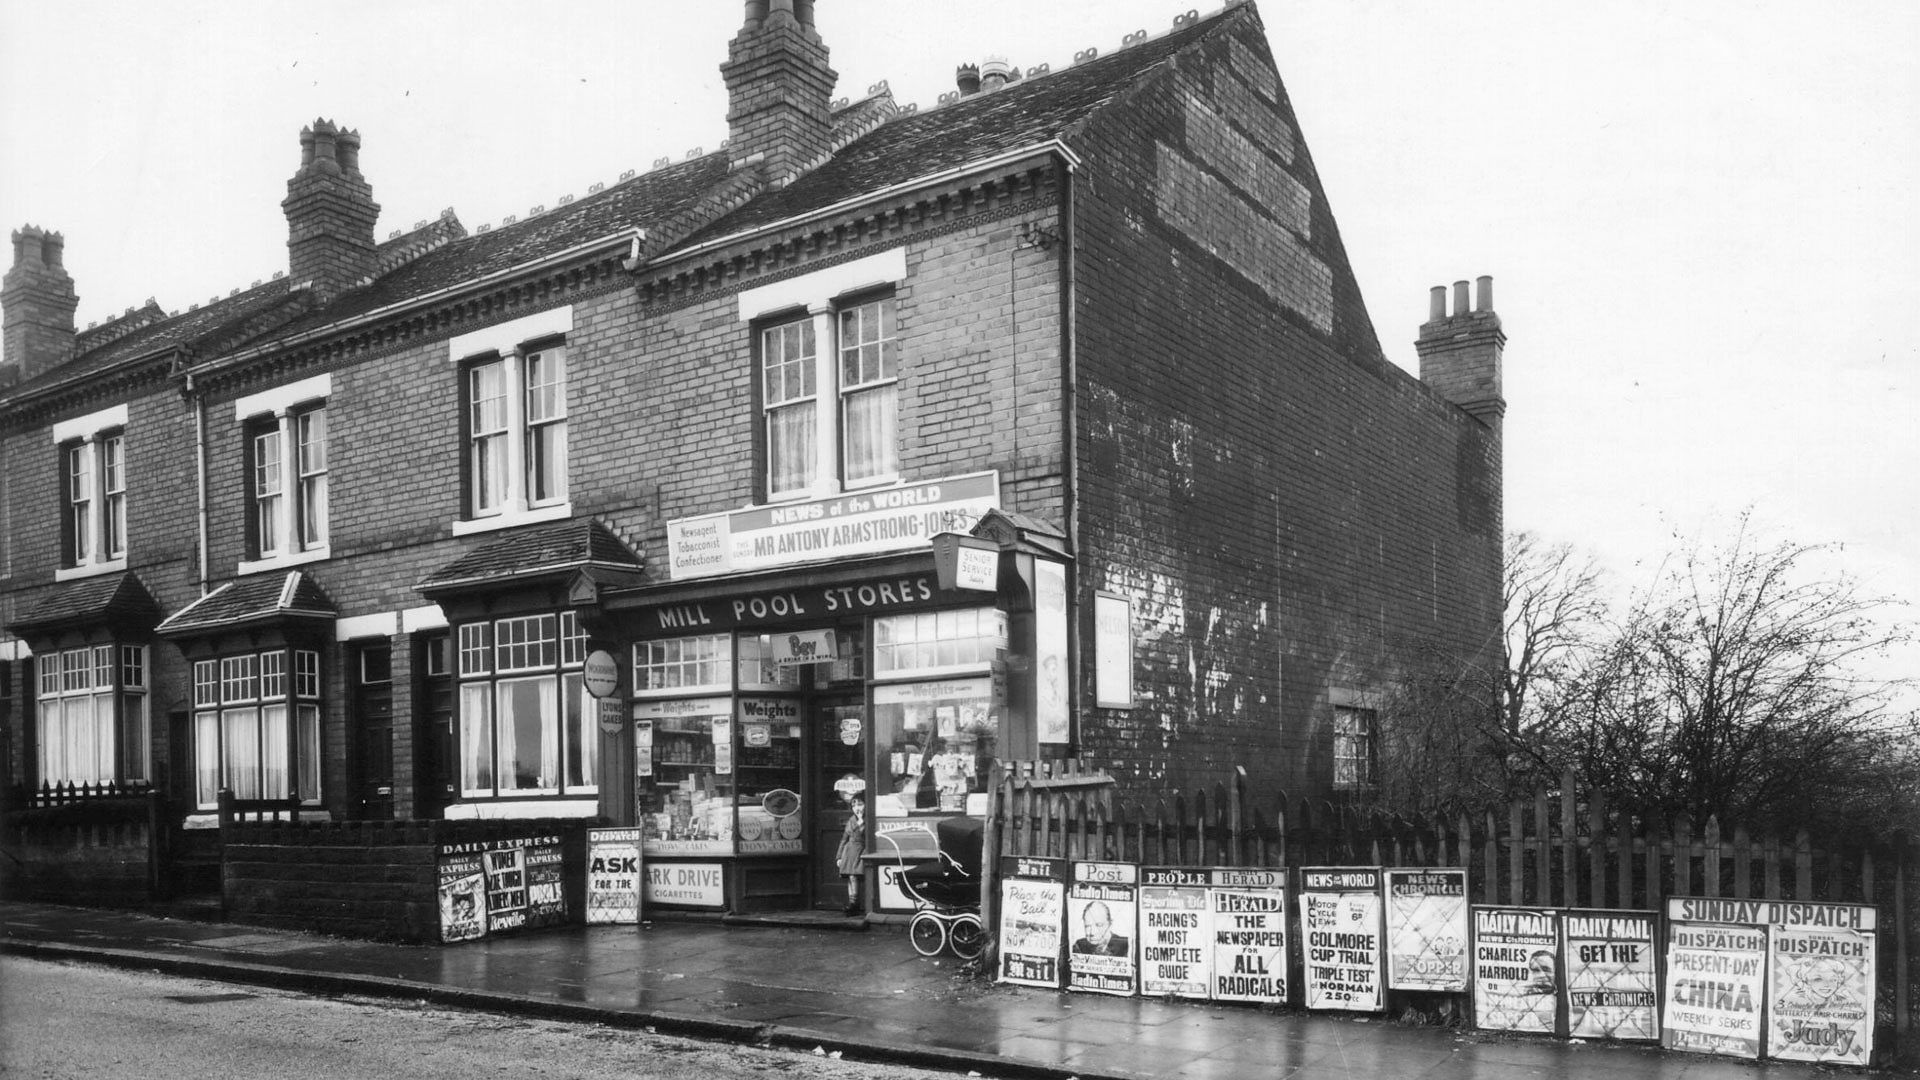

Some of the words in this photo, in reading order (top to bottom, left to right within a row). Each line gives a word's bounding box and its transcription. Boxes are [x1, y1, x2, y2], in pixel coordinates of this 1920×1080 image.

[771, 503, 824, 524] NEWS
[830, 501, 842, 516] of
[848, 498, 870, 512] the
[872, 486, 941, 508] WORLD
[680, 523, 716, 538] Newsagent
[677, 538, 720, 553] Tobacconist
[754, 535, 775, 558] MR
[778, 527, 830, 554] ANTONY
[676, 554, 722, 568] Confectioner
[964, 550, 991, 564] SENIOR
[962, 561, 992, 576] SERVICE
[657, 604, 710, 629] MILL
[733, 592, 805, 620] POOL
[824, 578, 931, 612] STORES
[912, 683, 954, 698] Weights
[602, 702, 622, 712] LYONS
[662, 702, 696, 715] Weights
[744, 702, 796, 719] Weights
[602, 714, 622, 724] CAKES
[443, 842, 490, 854] DAILY
[498, 836, 560, 848] EXPRESS
[526, 854, 562, 864] EXPRESS
[590, 858, 638, 873] ASK
[440, 863, 480, 874] EXPRESS
[1018, 864, 1050, 876] Mail
[1086, 864, 1123, 881] Post
[595, 880, 611, 889] FOR
[616, 880, 632, 889] THE
[678, 869, 720, 887] DRIVE
[1148, 872, 1205, 884] PEOPLE
[1222, 872, 1275, 885] HERALD
[1307, 874, 1333, 887] NEWS
[1342, 874, 1375, 887] WORLD
[1408, 875, 1447, 884] NEWS
[655, 889, 703, 899] CIGARETTES
[1073, 884, 1101, 899] Radio
[1101, 886, 1131, 900] Times
[1392, 884, 1463, 894] CHRONICLE
[1216, 894, 1282, 912] HERALD
[1308, 896, 1337, 908] MOTOR
[1148, 913, 1198, 928] RACING'S
[1308, 908, 1337, 918] CYCLE
[1682, 900, 1761, 923] SUNDAY
[1768, 904, 1861, 928] DISPATCH
[1234, 915, 1266, 928] THE
[1308, 918, 1336, 928] NEWS
[1479, 914, 1516, 934] DAILY
[1518, 915, 1554, 936] MAIL
[1569, 918, 1610, 938] DAILY
[1612, 919, 1650, 939] MAIL
[1158, 930, 1188, 945] MOST
[1217, 931, 1284, 946] NEWSPAPER
[1310, 932, 1375, 950] COLMORE
[1480, 935, 1503, 943] NEWS
[1506, 937, 1554, 945] CHRONICLE
[1678, 933, 1757, 949] DISPATCH
[1479, 947, 1527, 962] CHARLES
[1580, 945, 1606, 963] GET
[1610, 945, 1639, 963] THE
[1780, 938, 1863, 956] DISPATCH
[1145, 947, 1202, 963] COMPLETE
[1310, 949, 1335, 962] CUP
[1338, 950, 1373, 965] TRIAL
[1009, 960, 1050, 980] Mail
[1158, 964, 1189, 979] GUIDE
[1234, 955, 1269, 974] ALL
[1674, 953, 1759, 976] PRESENT-DAY
[1479, 966, 1528, 980] HARROLD
[1071, 972, 1098, 987] Radio
[1098, 975, 1129, 990] Times
[1218, 976, 1285, 996] RADICALS
[1319, 982, 1373, 993] NORMAN
[1572, 993, 1597, 1006] NEWS
[1602, 993, 1654, 1006] CHRONICLE
[1673, 978, 1753, 1013] CHINA
[1673, 1011, 1713, 1026] WEEKLY
[1719, 1017, 1752, 1030] SERIES
